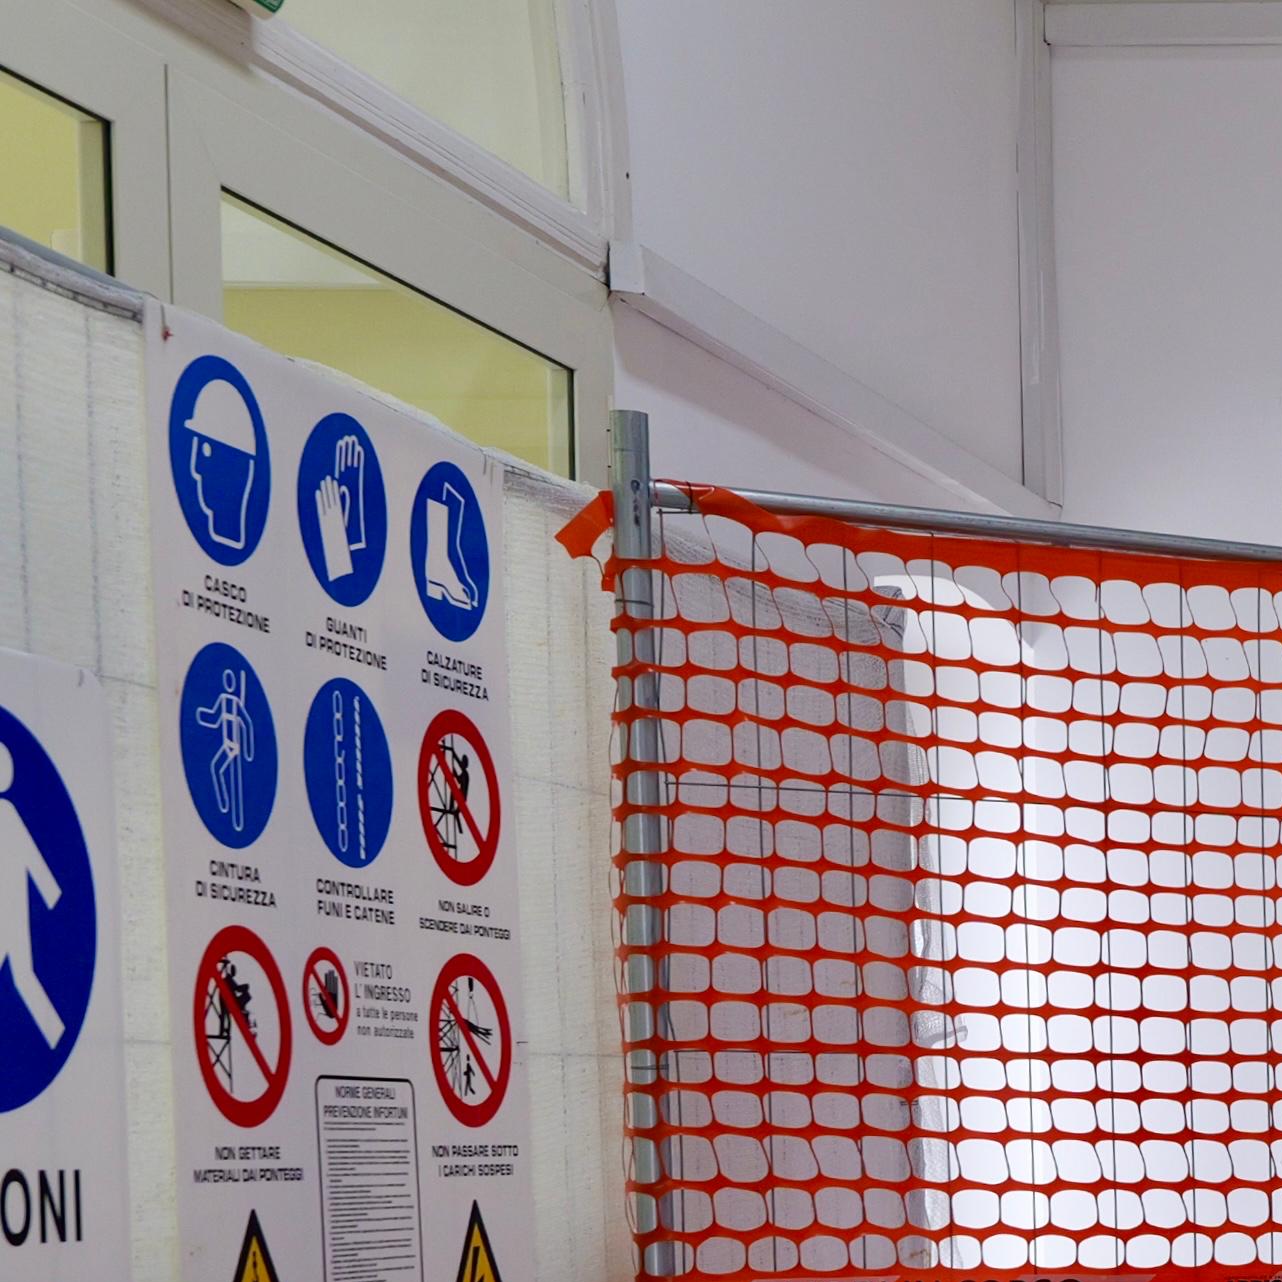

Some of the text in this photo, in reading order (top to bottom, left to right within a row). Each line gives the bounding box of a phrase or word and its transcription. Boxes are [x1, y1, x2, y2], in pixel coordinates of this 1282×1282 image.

[204, 574, 246, 603] CASCO
[183, 590, 269, 633] DI PROTEZIONE
[326, 617, 367, 643] GUANTI
[306, 632, 387, 670] DI PROTEZIONE
[427, 651, 482, 680] CALZATURE
[421, 669, 489, 701] DI SICUREZZA
[210, 860, 260, 883] CINTURA
[196, 880, 276, 907] DI SICUREZZA
[317, 879, 394, 904] CONTROLLARE
[318, 900, 394, 925] FUNI CATENE
[354, 961, 392, 979] VIETATO
[365, 984, 411, 1002] INGRESSO
[215, 1147, 280, 1160] NON GETTARE
[432, 1145, 518, 1158] NON PASSARE SOTTO
[194, 1168, 303, 1182] MATERIALI PONTEGGI
[443, 1163, 513, 1177] CARICHI SOSPESI
[0, 1168, 82, 1246] ONI
